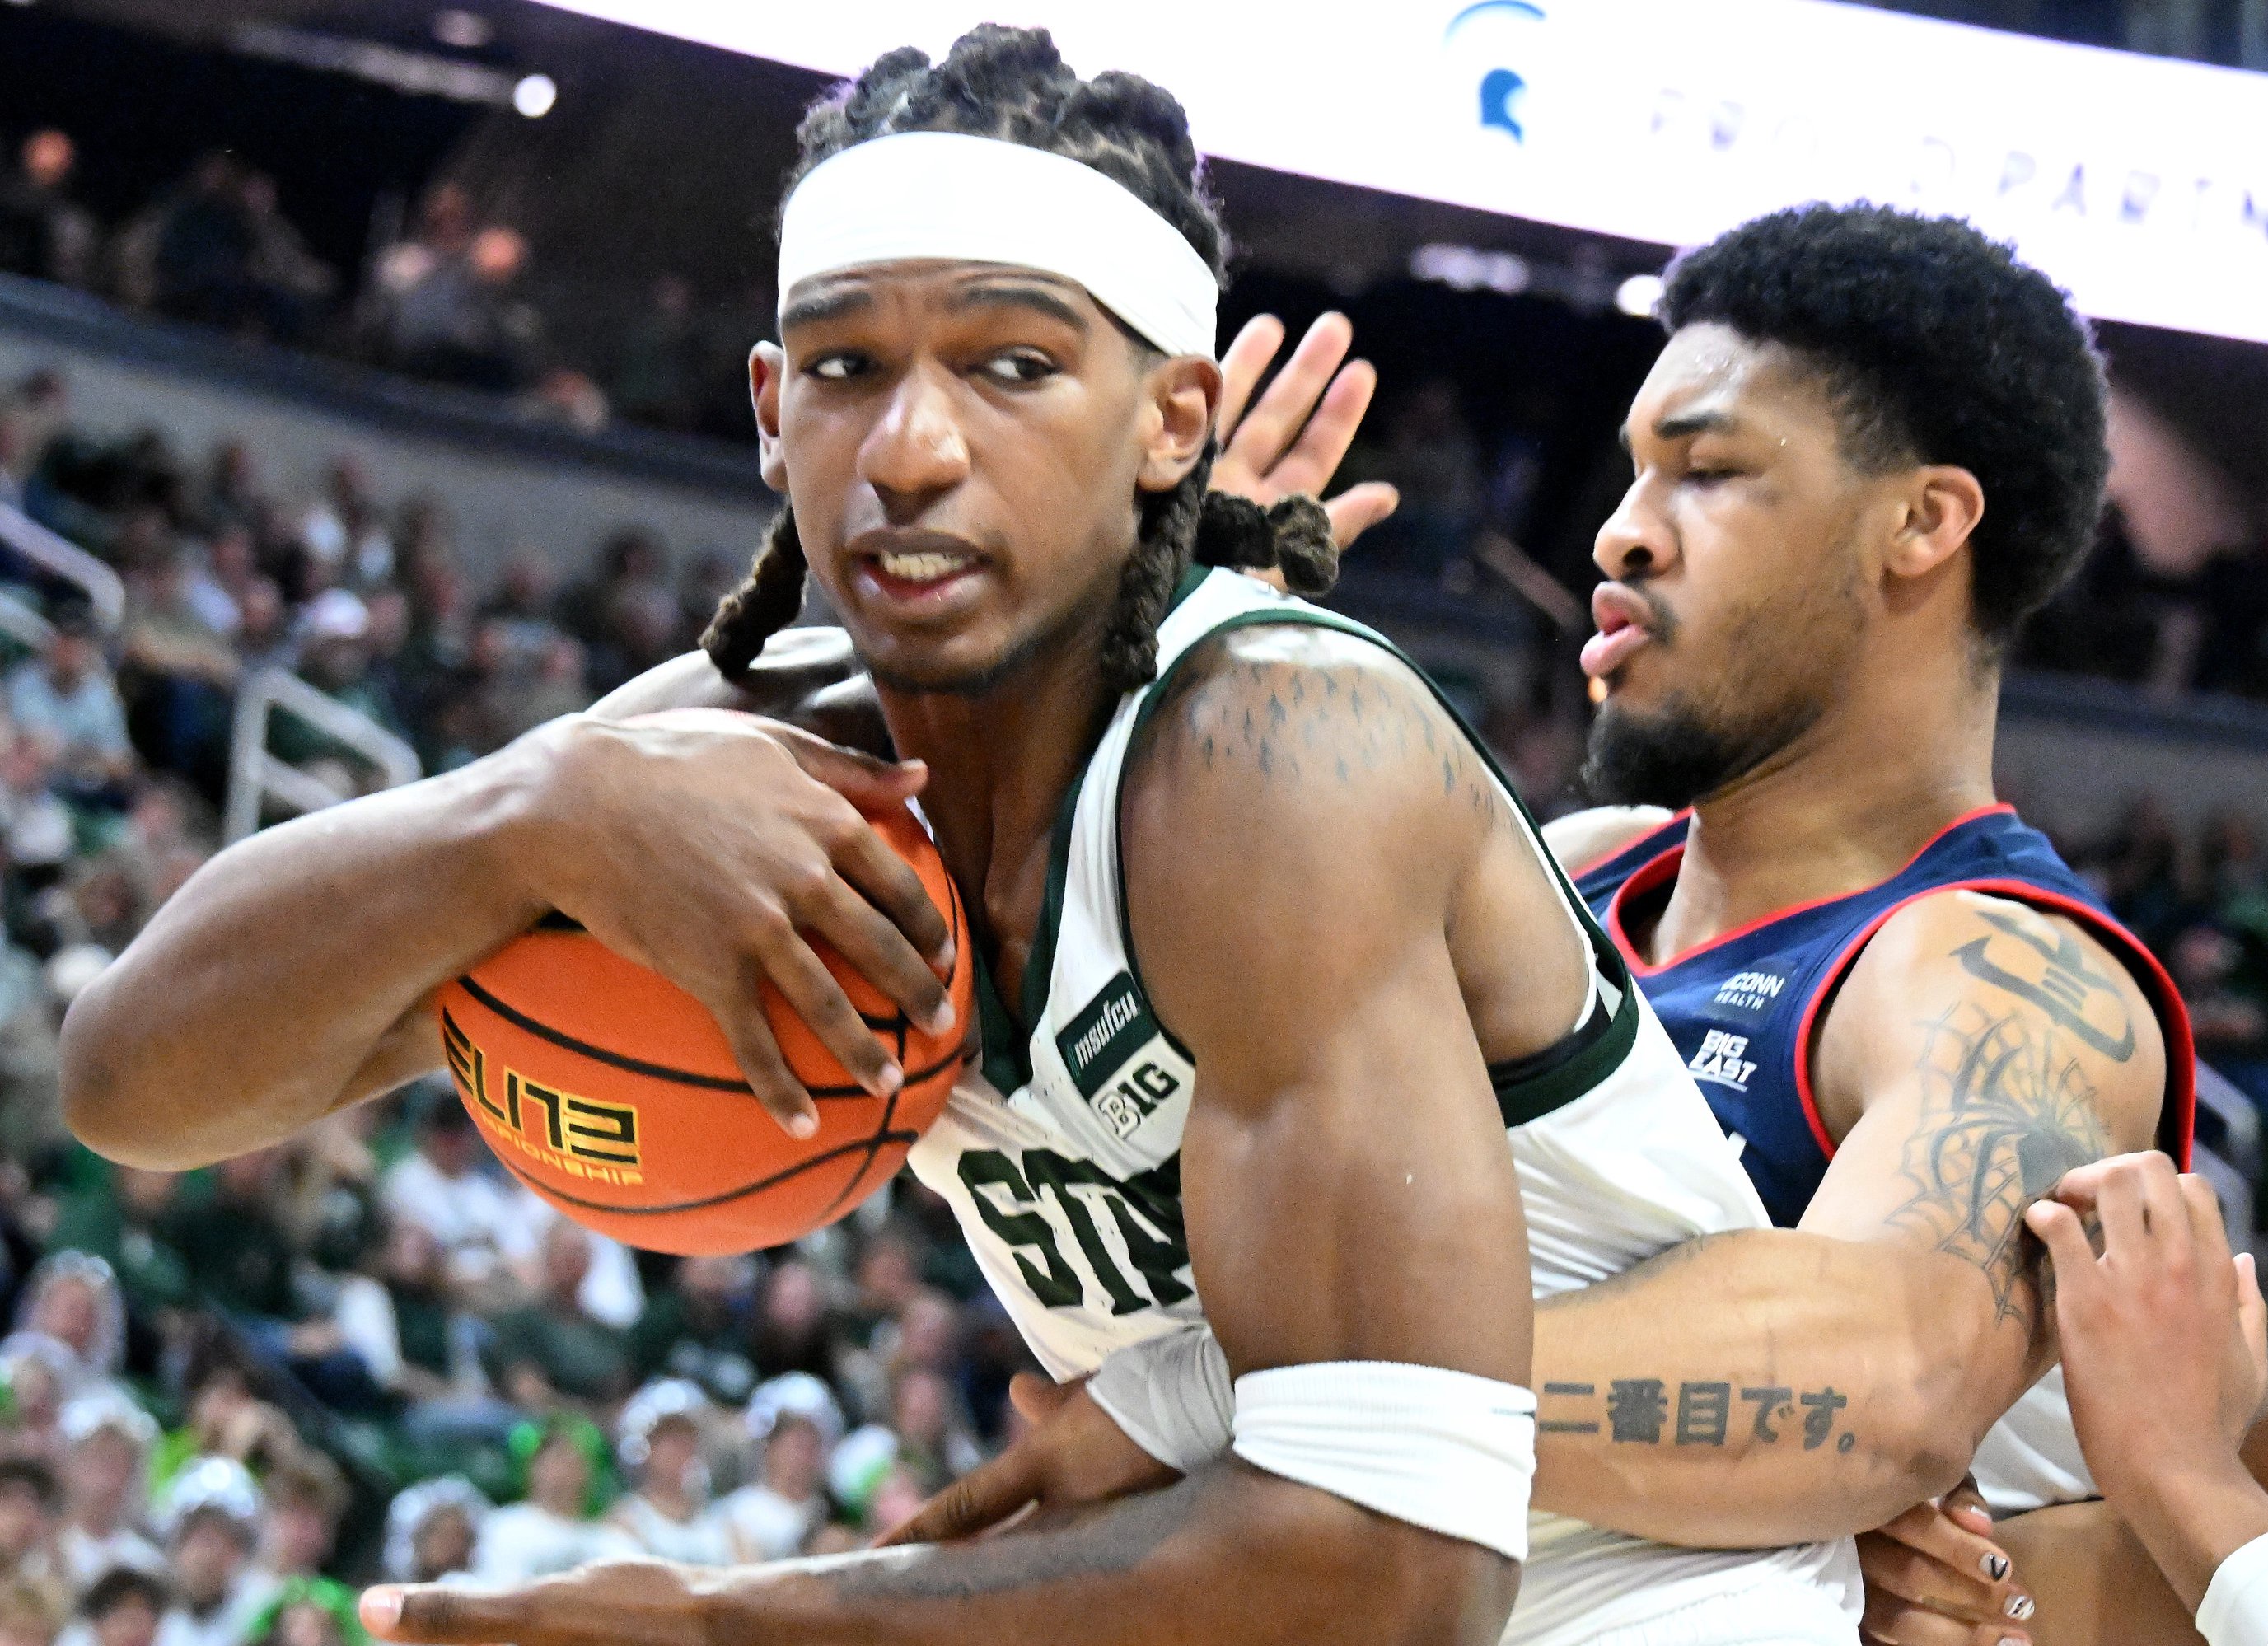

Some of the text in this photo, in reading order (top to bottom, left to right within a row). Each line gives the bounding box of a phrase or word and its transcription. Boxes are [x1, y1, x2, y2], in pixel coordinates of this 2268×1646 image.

[1714, 991, 1765, 1012] HEALTH
[1074, 990, 1141, 1070] msufcu
[1700, 1028, 1749, 1059] BIG
[1688, 1050, 1758, 1083] EAST
